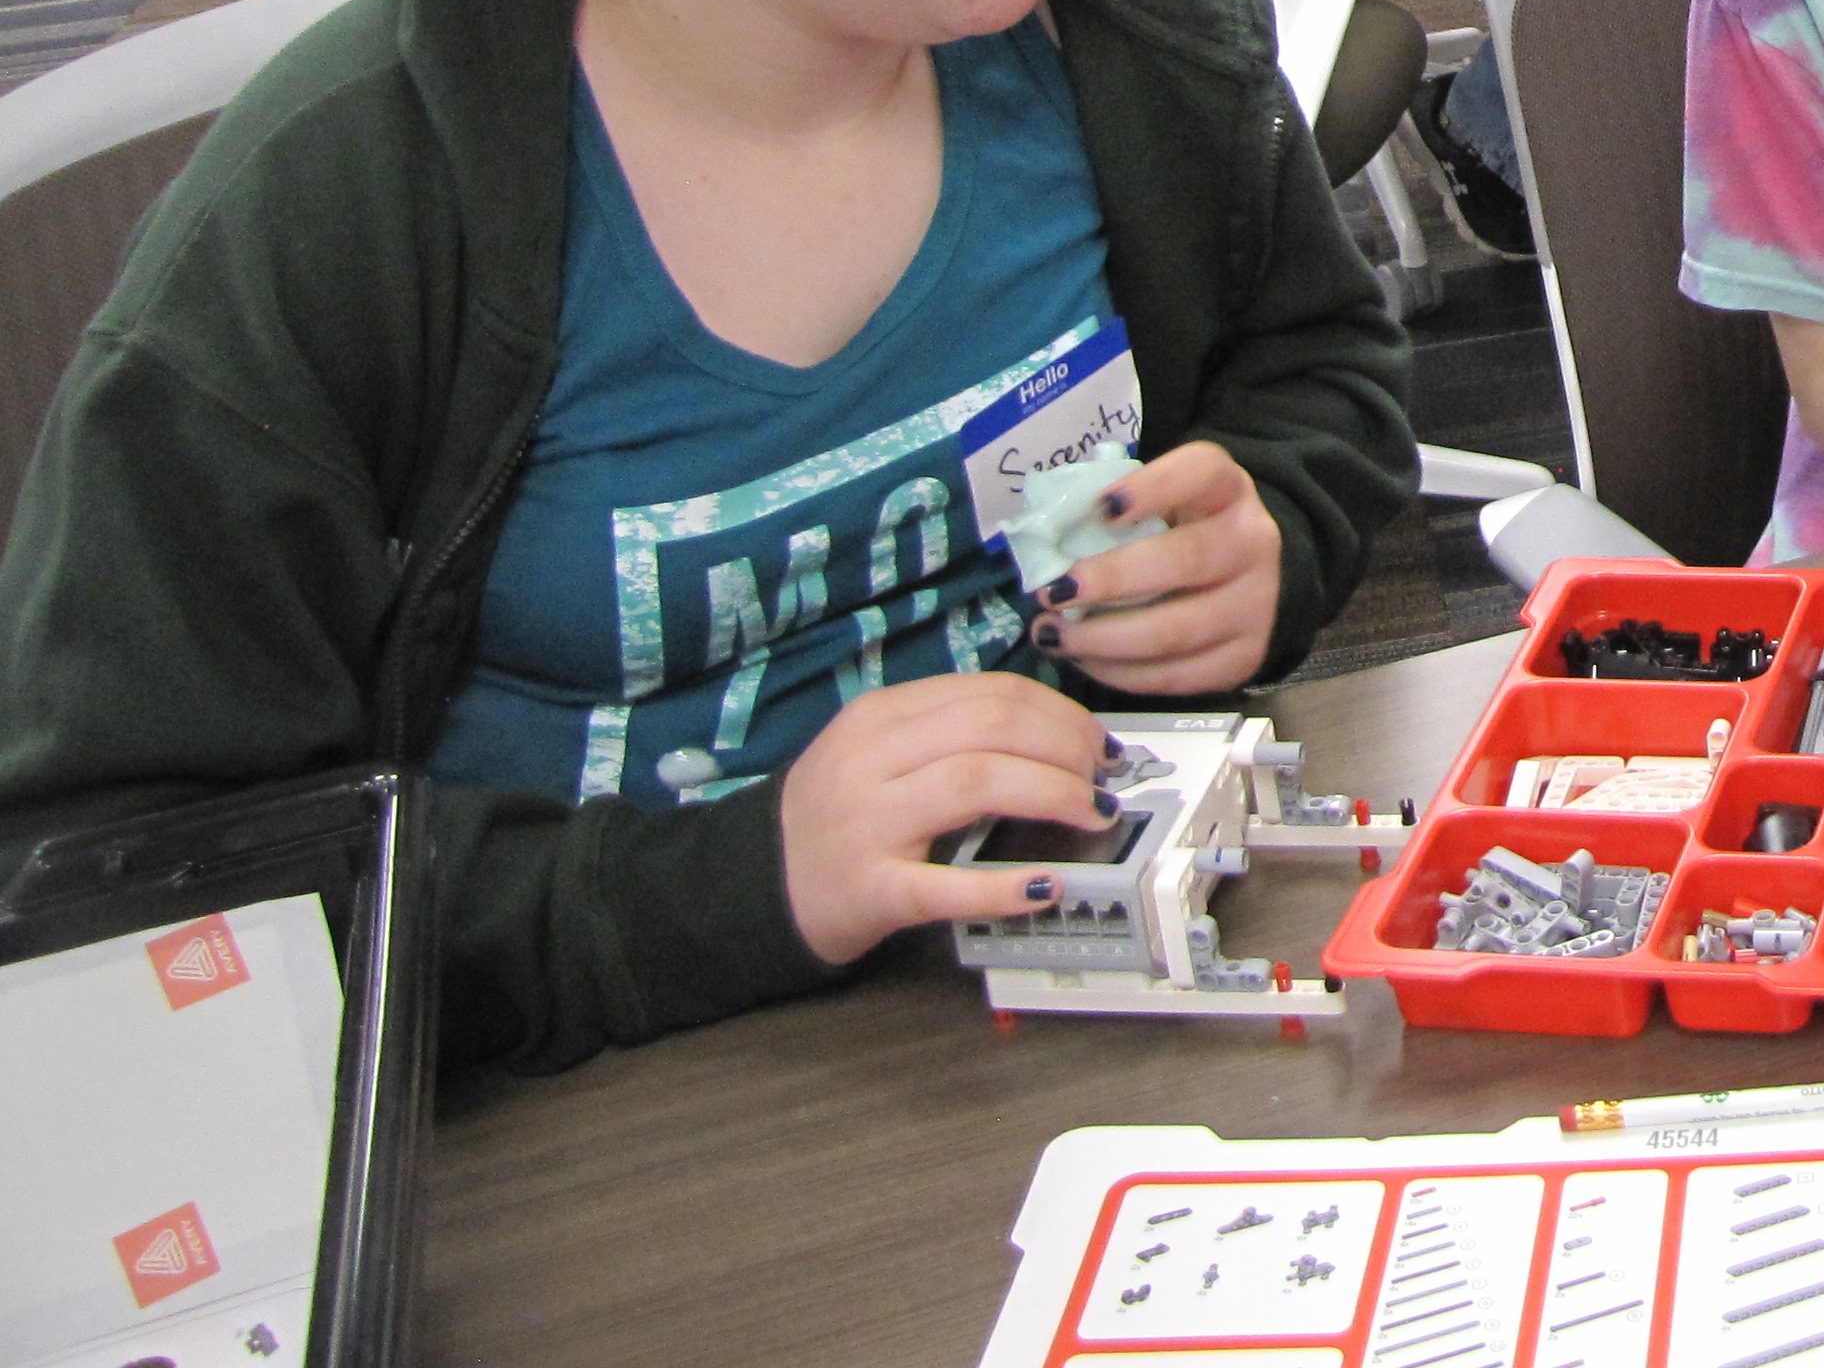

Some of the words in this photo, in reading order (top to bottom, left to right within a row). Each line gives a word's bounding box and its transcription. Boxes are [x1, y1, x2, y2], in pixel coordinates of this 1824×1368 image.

[1019, 363, 1069, 404] Hello
[211, 930, 237, 972] AVERY
[1646, 1128, 1719, 1149] 45544
[181, 1220, 207, 1264] AVERY
